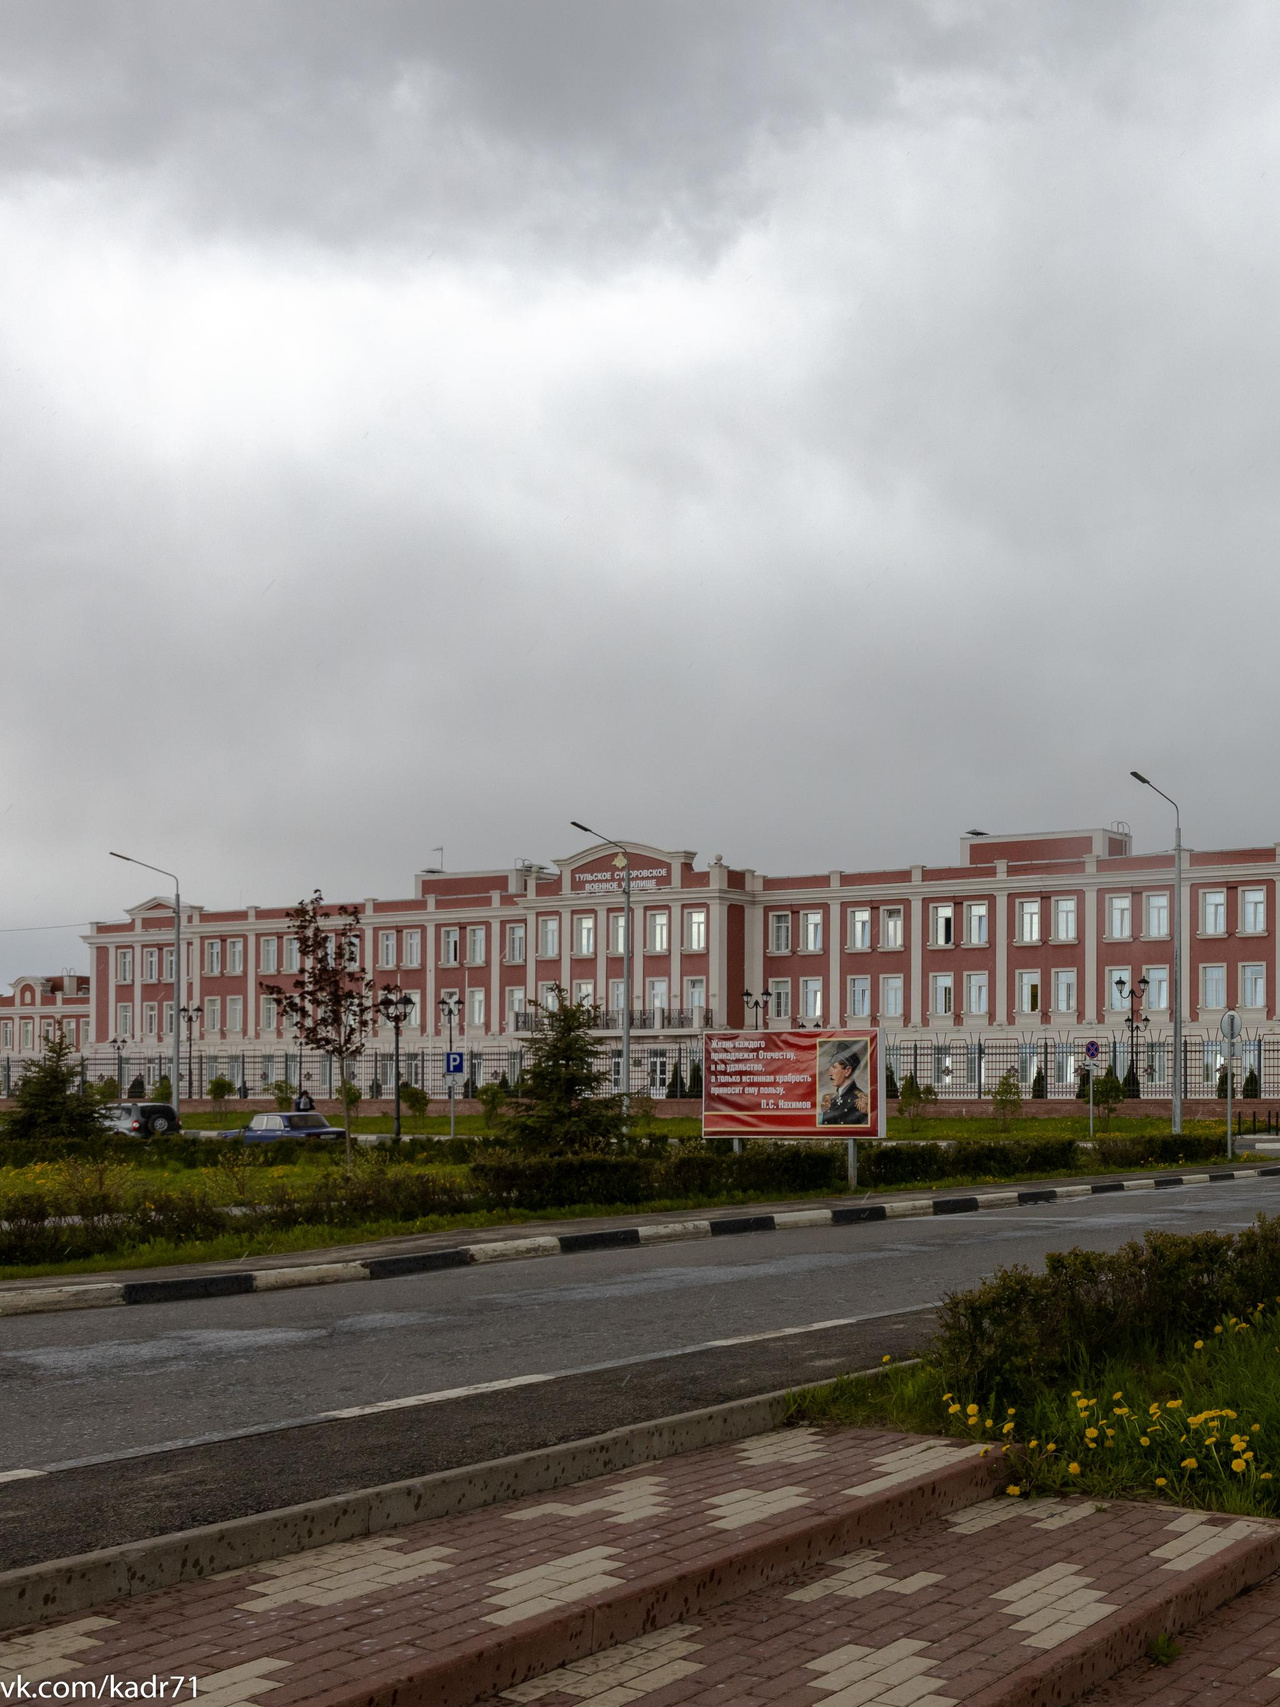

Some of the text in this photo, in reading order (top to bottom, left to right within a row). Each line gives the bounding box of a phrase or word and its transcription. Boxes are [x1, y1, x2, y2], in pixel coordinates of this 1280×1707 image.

[575, 872, 612, 882] ТУЛЬСКОЕ
[585, 879, 657, 891] ВОЕННОЕ УИЛИЩЕ
[711, 1040, 766, 1049] Жизнь каждого
[710, 1050, 796, 1061] принадлежит Отечеству,
[726, 1063, 765, 1072] удальство,
[776, 1074, 812, 1084] храбрость
[710, 1086, 785, 1095] приносит ему пользу.
[761, 1099, 811, 1109] П.С. Нахимов
